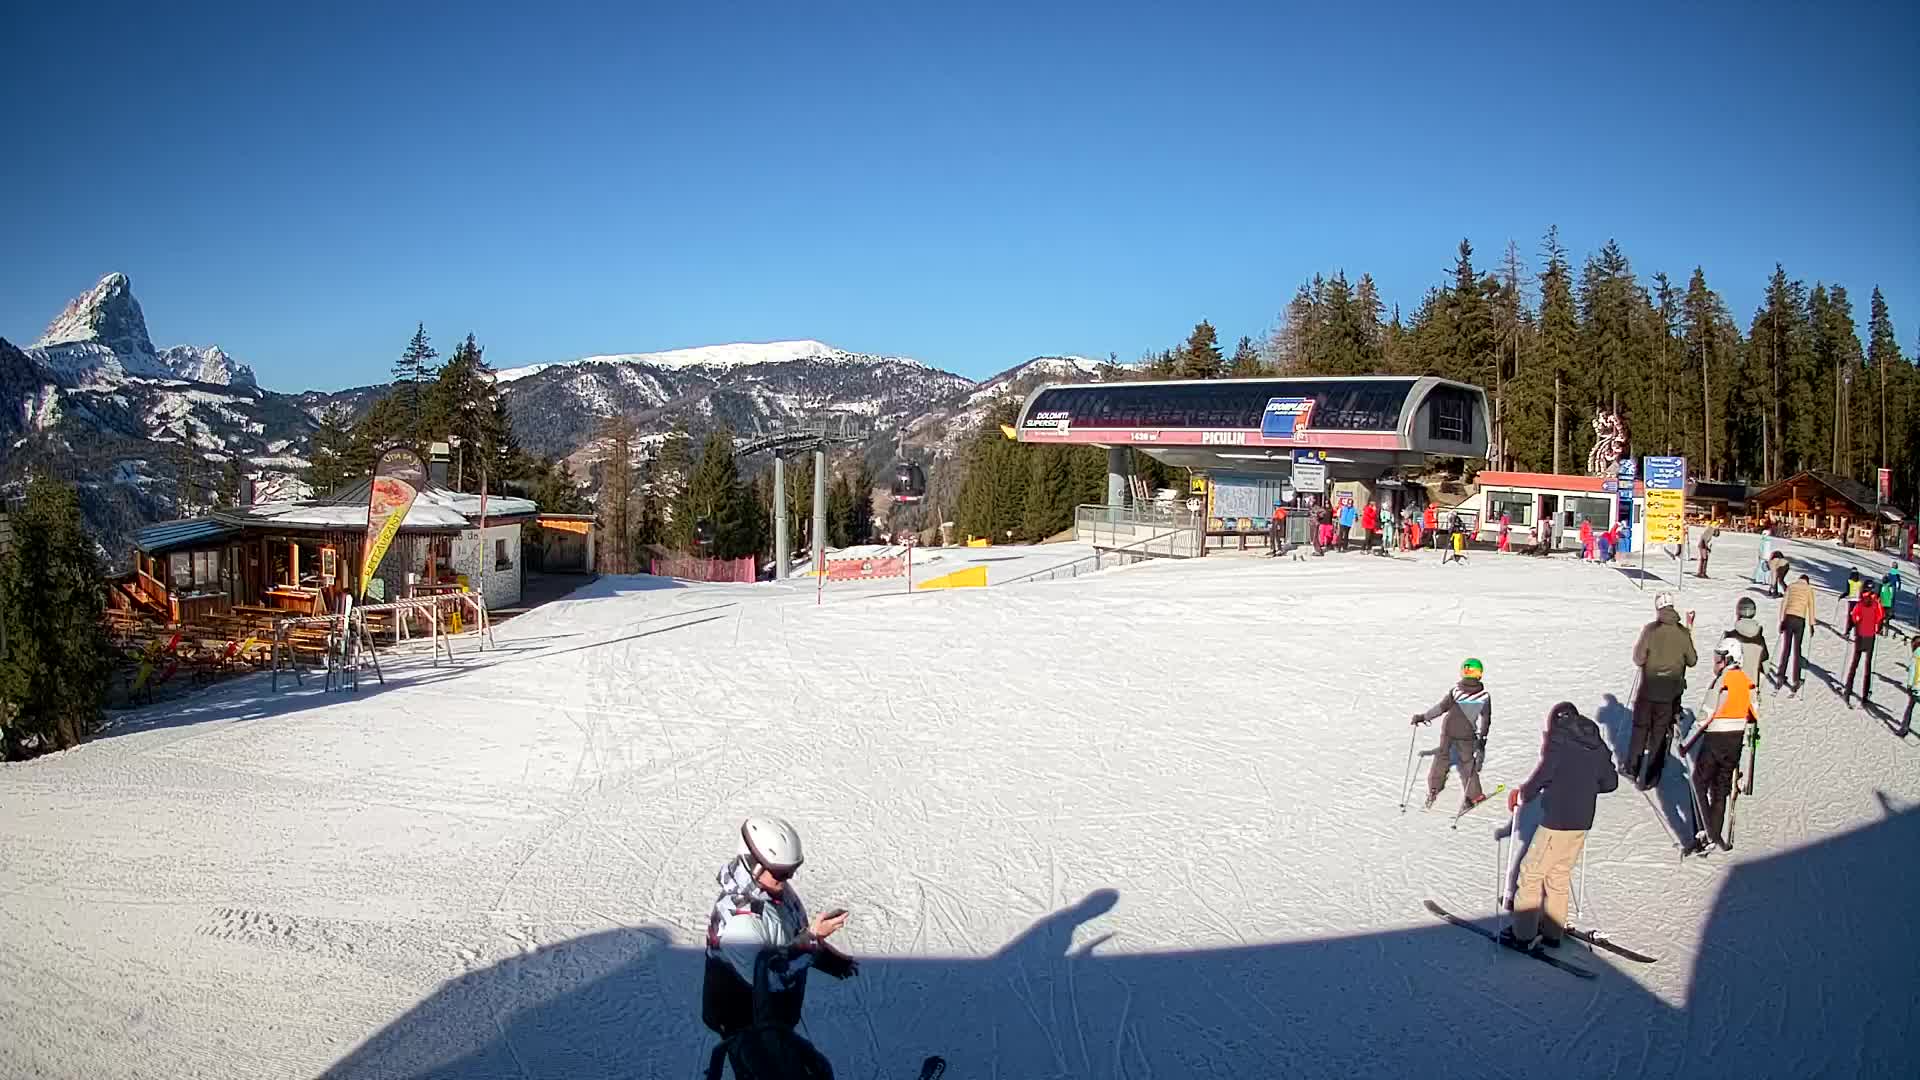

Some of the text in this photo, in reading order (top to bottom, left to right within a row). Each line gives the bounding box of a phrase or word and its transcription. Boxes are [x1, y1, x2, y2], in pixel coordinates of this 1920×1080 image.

[1037, 412, 1069, 420] DOLOMITI
[1202, 432, 1245, 445] PICULIN
[365, 511, 401, 576] RESTAURANT
